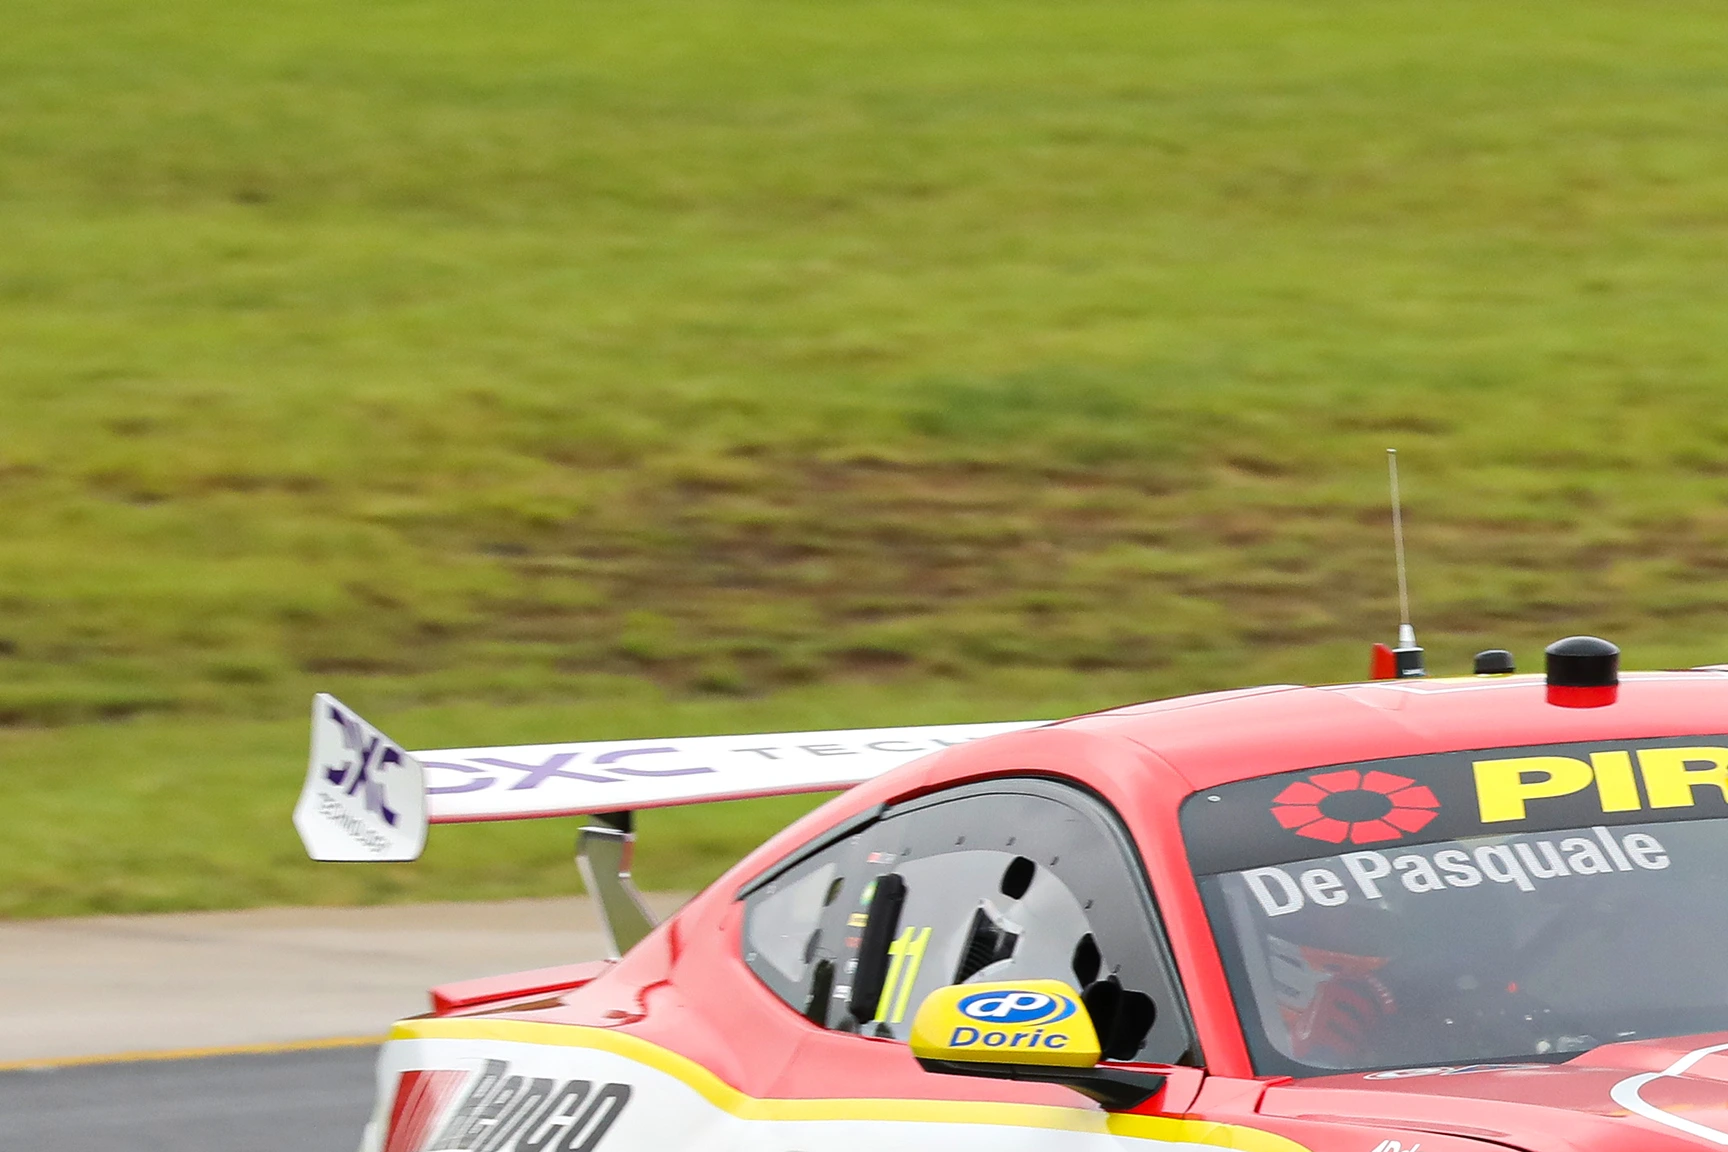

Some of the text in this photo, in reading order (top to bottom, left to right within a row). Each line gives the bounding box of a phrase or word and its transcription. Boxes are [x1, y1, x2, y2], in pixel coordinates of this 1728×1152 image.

[1241, 826, 1672, 917] De Pasquale
[873, 926, 933, 1024] 11
[948, 1026, 1071, 1049] Doric
